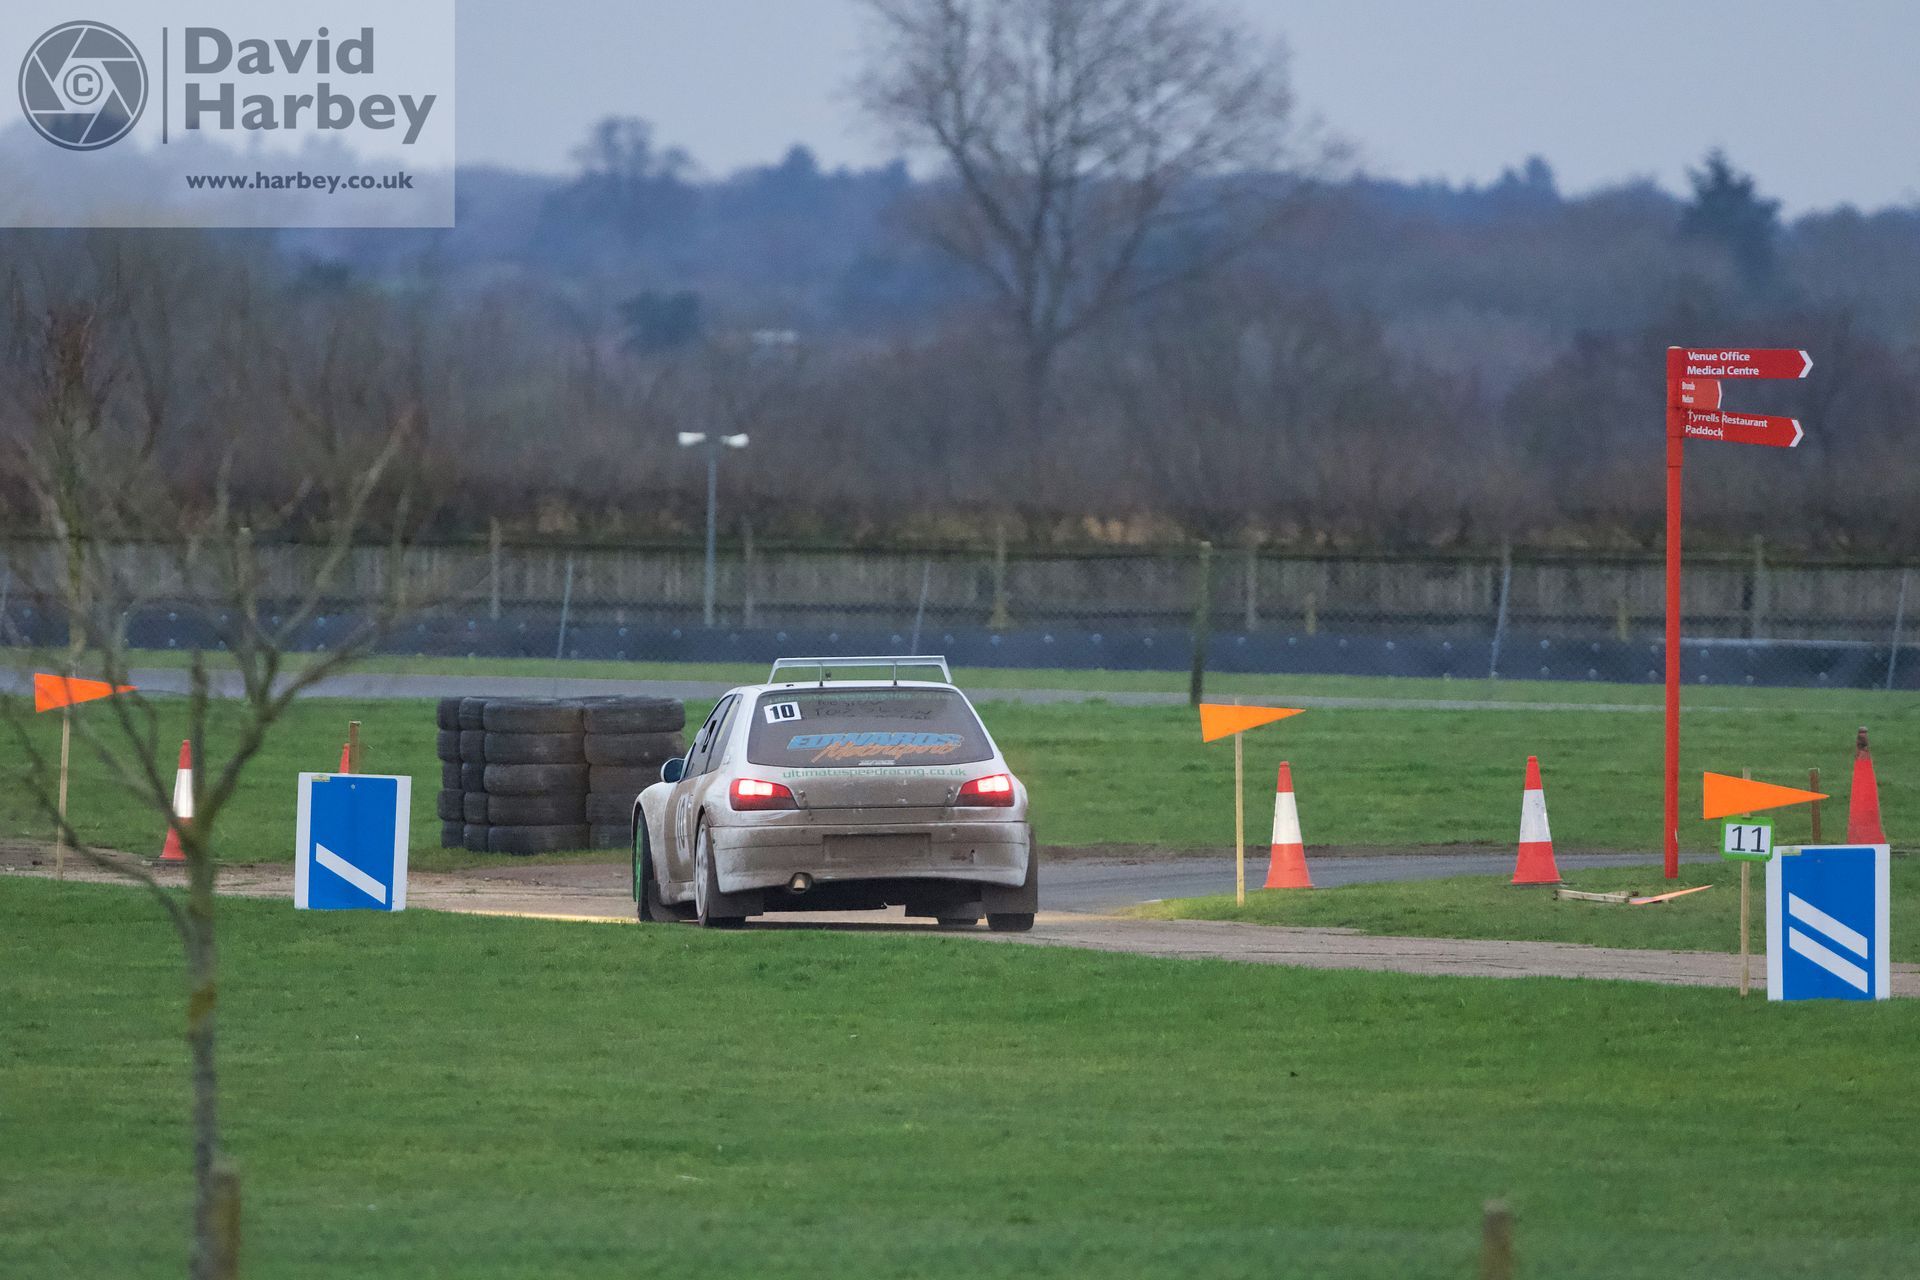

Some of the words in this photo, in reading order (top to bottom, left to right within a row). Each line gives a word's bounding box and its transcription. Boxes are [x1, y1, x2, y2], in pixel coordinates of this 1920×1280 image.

[1688, 352, 1718, 361] Venue
[1720, 351, 1751, 361] Office
[1687, 365, 1725, 375] Medical
[1727, 366, 1760, 376] Centre
[1688, 411, 1720, 423] Tyrrells
[1722, 414, 1768, 427] Restaurant
[1685, 425, 1723, 437] Paddock
[769, 704, 795, 720] 10
[787, 731, 965, 750] EDWARDS
[782, 766, 967, 779] ultimatespeedracing.co.uk
[1731, 826, 1765, 852] 11
